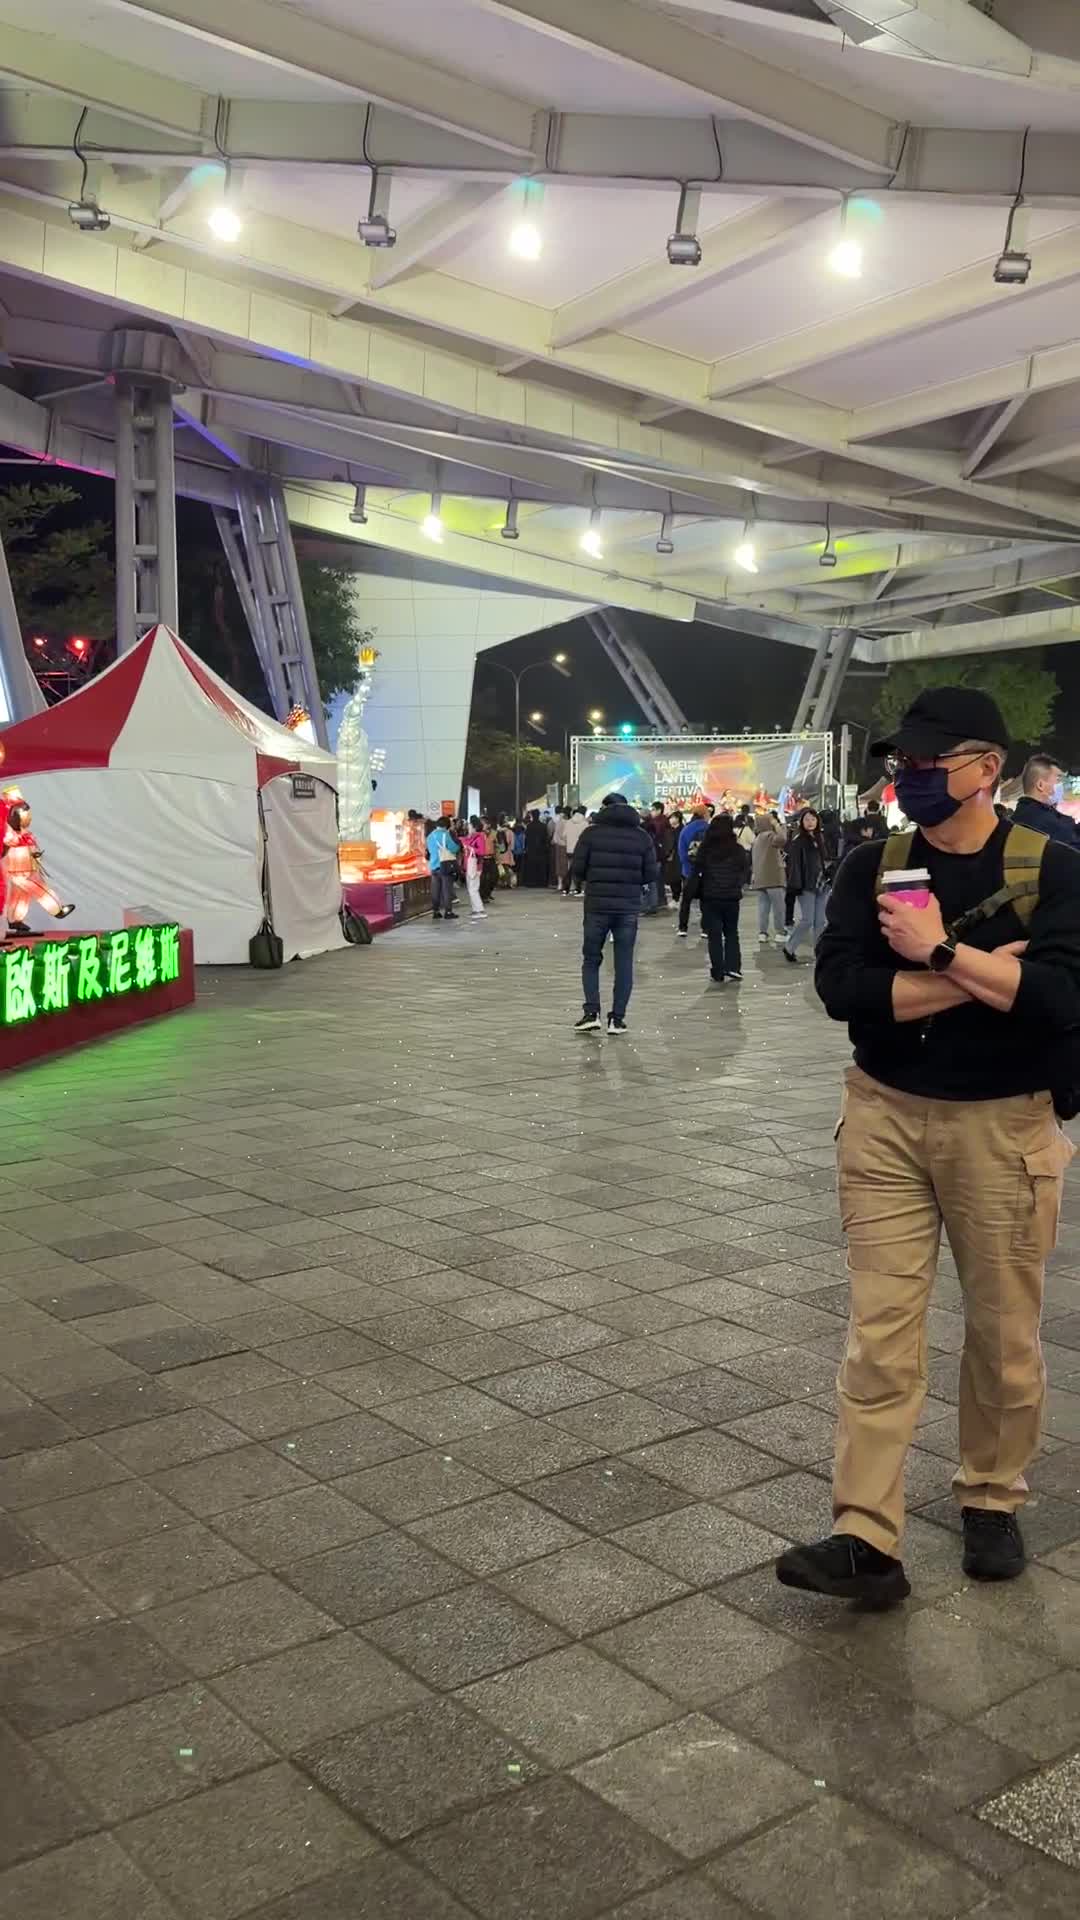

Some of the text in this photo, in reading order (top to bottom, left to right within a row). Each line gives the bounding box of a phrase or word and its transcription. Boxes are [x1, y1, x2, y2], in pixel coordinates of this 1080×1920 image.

[654, 760, 688, 770] TAIPEI
[654, 773, 708, 784] LANTERN
[654, 785, 706, 796] FESTIVA
